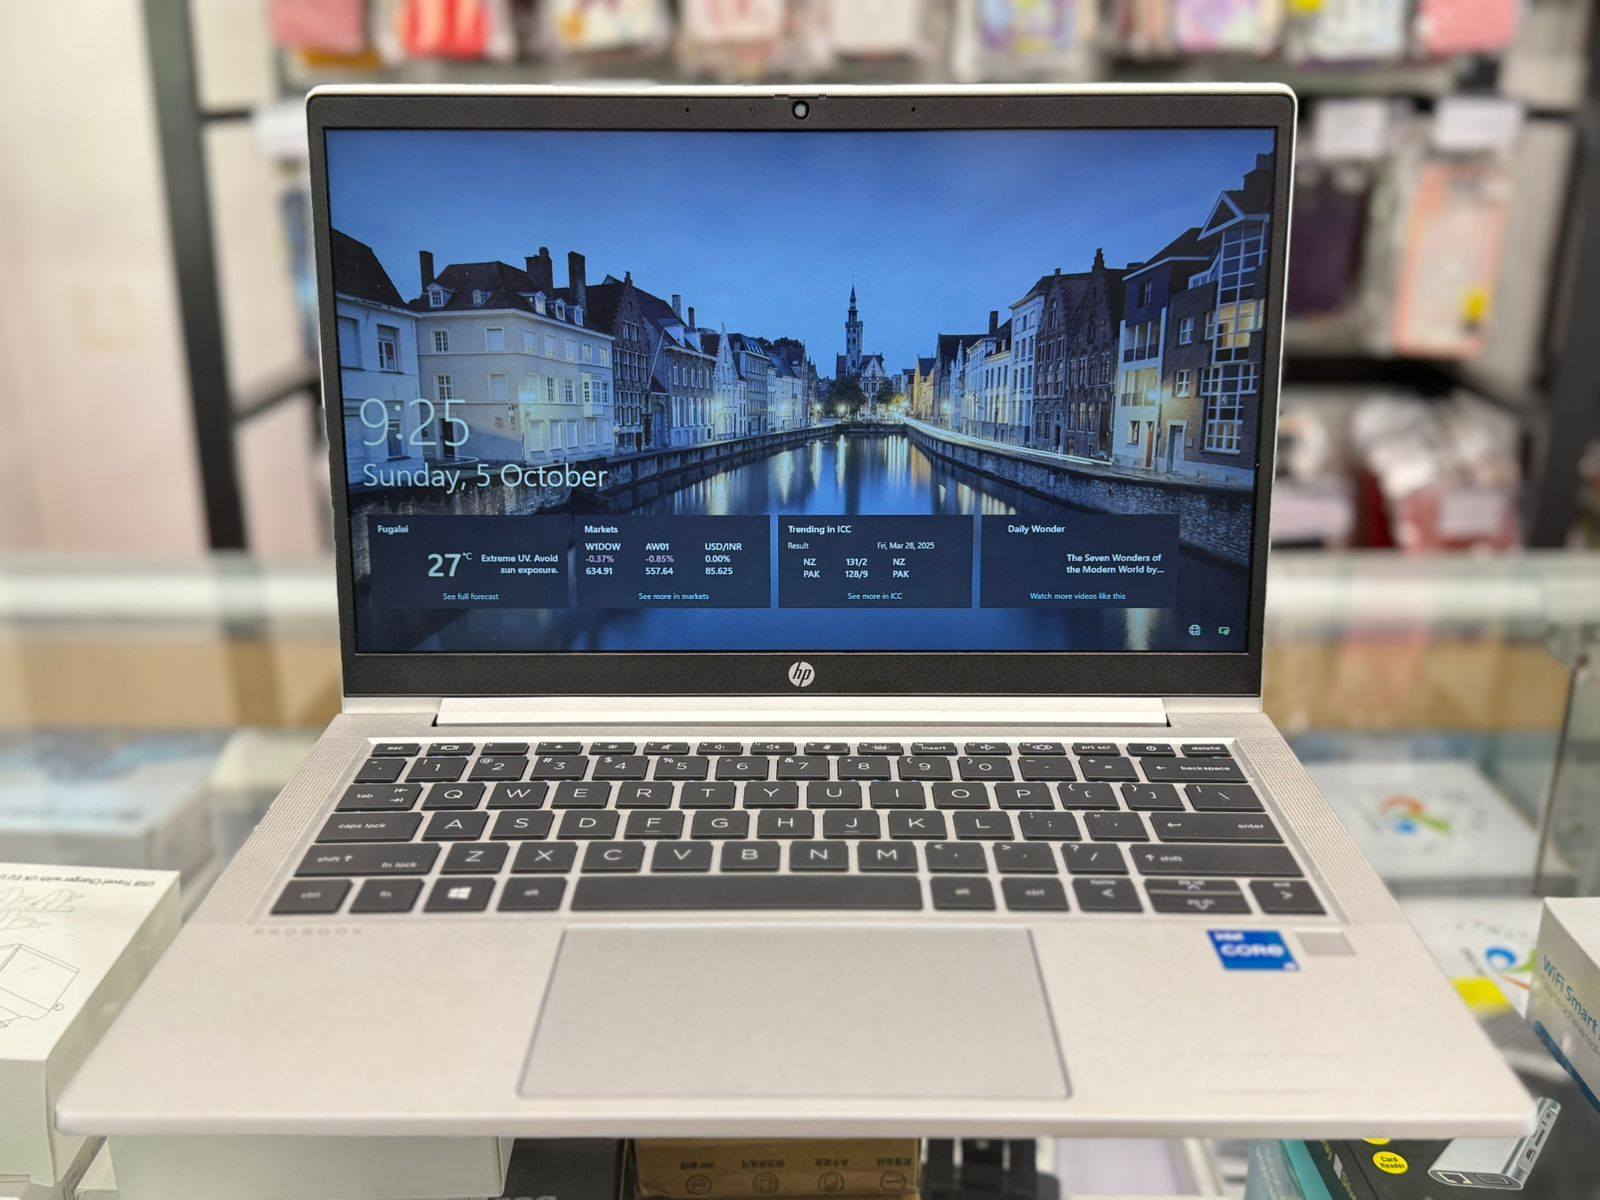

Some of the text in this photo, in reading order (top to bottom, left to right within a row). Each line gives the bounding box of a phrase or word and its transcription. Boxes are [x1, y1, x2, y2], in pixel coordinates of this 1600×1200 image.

[359, 398, 470, 447] 9:25
[363, 463, 608, 495] Sunday, 5 October
[584, 525, 619, 533] Markets
[788, 525, 852, 535] Trending in ICC
[1007, 525, 1066, 535] Daily Wonder
[705, 542, 743, 552] USD/INR
[787, 541, 809, 550] Result
[877, 541, 935, 550] Fri, Mar 28, 2025
[481, 554, 559, 563] Extreme UV. Avoid
[585, 555, 615, 563] -0.37%
[645, 555, 675, 563] -0.85%
[705, 555, 731, 563] 0.00%
[1066, 553, 1162, 562] The Seven Wonders of
[803, 558, 906, 567] NZ 131/2 NZ
[518, 566, 559, 576] exposure.
[586, 567, 613, 575] 634.91
[645, 567, 674, 575] 557.64
[705, 567, 733, 575] 85.625
[1066, 565, 1081, 574] the
[1082, 565, 1116, 574] Modern
[1118, 565, 1145, 574] World
[803, 570, 909, 579] PAK 128/9 PAK
[443, 592, 499, 600] See full forecast
[638, 592, 652, 600] See
[673, 592, 680, 600] in
[681, 592, 710, 600] markets
[848, 592, 861, 600] See
[882, 592, 889, 600] in
[890, 592, 902, 600] ICC
[1029, 592, 1052, 600] Watch
[1074, 592, 1098, 600] videos
[1098, 592, 1111, 600] like
[1112, 592, 1126, 600] this
[791, 661, 813, 687] hp
[492, 763, 505, 771] 2
[553, 762, 566, 771] 3
[614, 762, 627, 770] 4
[676, 762, 687, 770] 5
[736, 762, 748, 770] 6
[798, 762, 809, 770] 7
[858, 762, 870, 771] 8
[918, 762, 931, 771] 9
[1180, 764, 1231, 772] backspace
[444, 789, 463, 799] Q
[506, 789, 531, 798] W
[573, 788, 589, 798] E
[636, 788, 652, 798] R
[701, 788, 715, 798] T
[763, 788, 780, 797] Y
[826, 788, 842, 798] U
[951, 788, 970, 798] O
[1016, 789, 1030, 799] P
[444, 819, 463, 829] A
[513, 818, 529, 828] S
[578, 818, 597, 828] D
[646, 818, 662, 828] F
[711, 818, 728, 828] G
[777, 817, 794, 828] H
[845, 817, 858, 828] J
[908, 818, 925, 828] K
[976, 818, 990, 828] L
[317, 855, 340, 863] shift
[465, 851, 484, 862] Z
[534, 850, 554, 861] X
[603, 850, 622, 860] C
[673, 849, 692, 860] V
[741, 849, 758, 860] B
[810, 849, 828, 860] N
[877, 849, 897, 860] M
[1160, 855, 1183, 863] shift
[40, 874, 62, 882] with
[63, 876, 102, 886] Charger
[102, 878, 132, 887] Travel
[1565, 985, 1598, 1034] Smart
